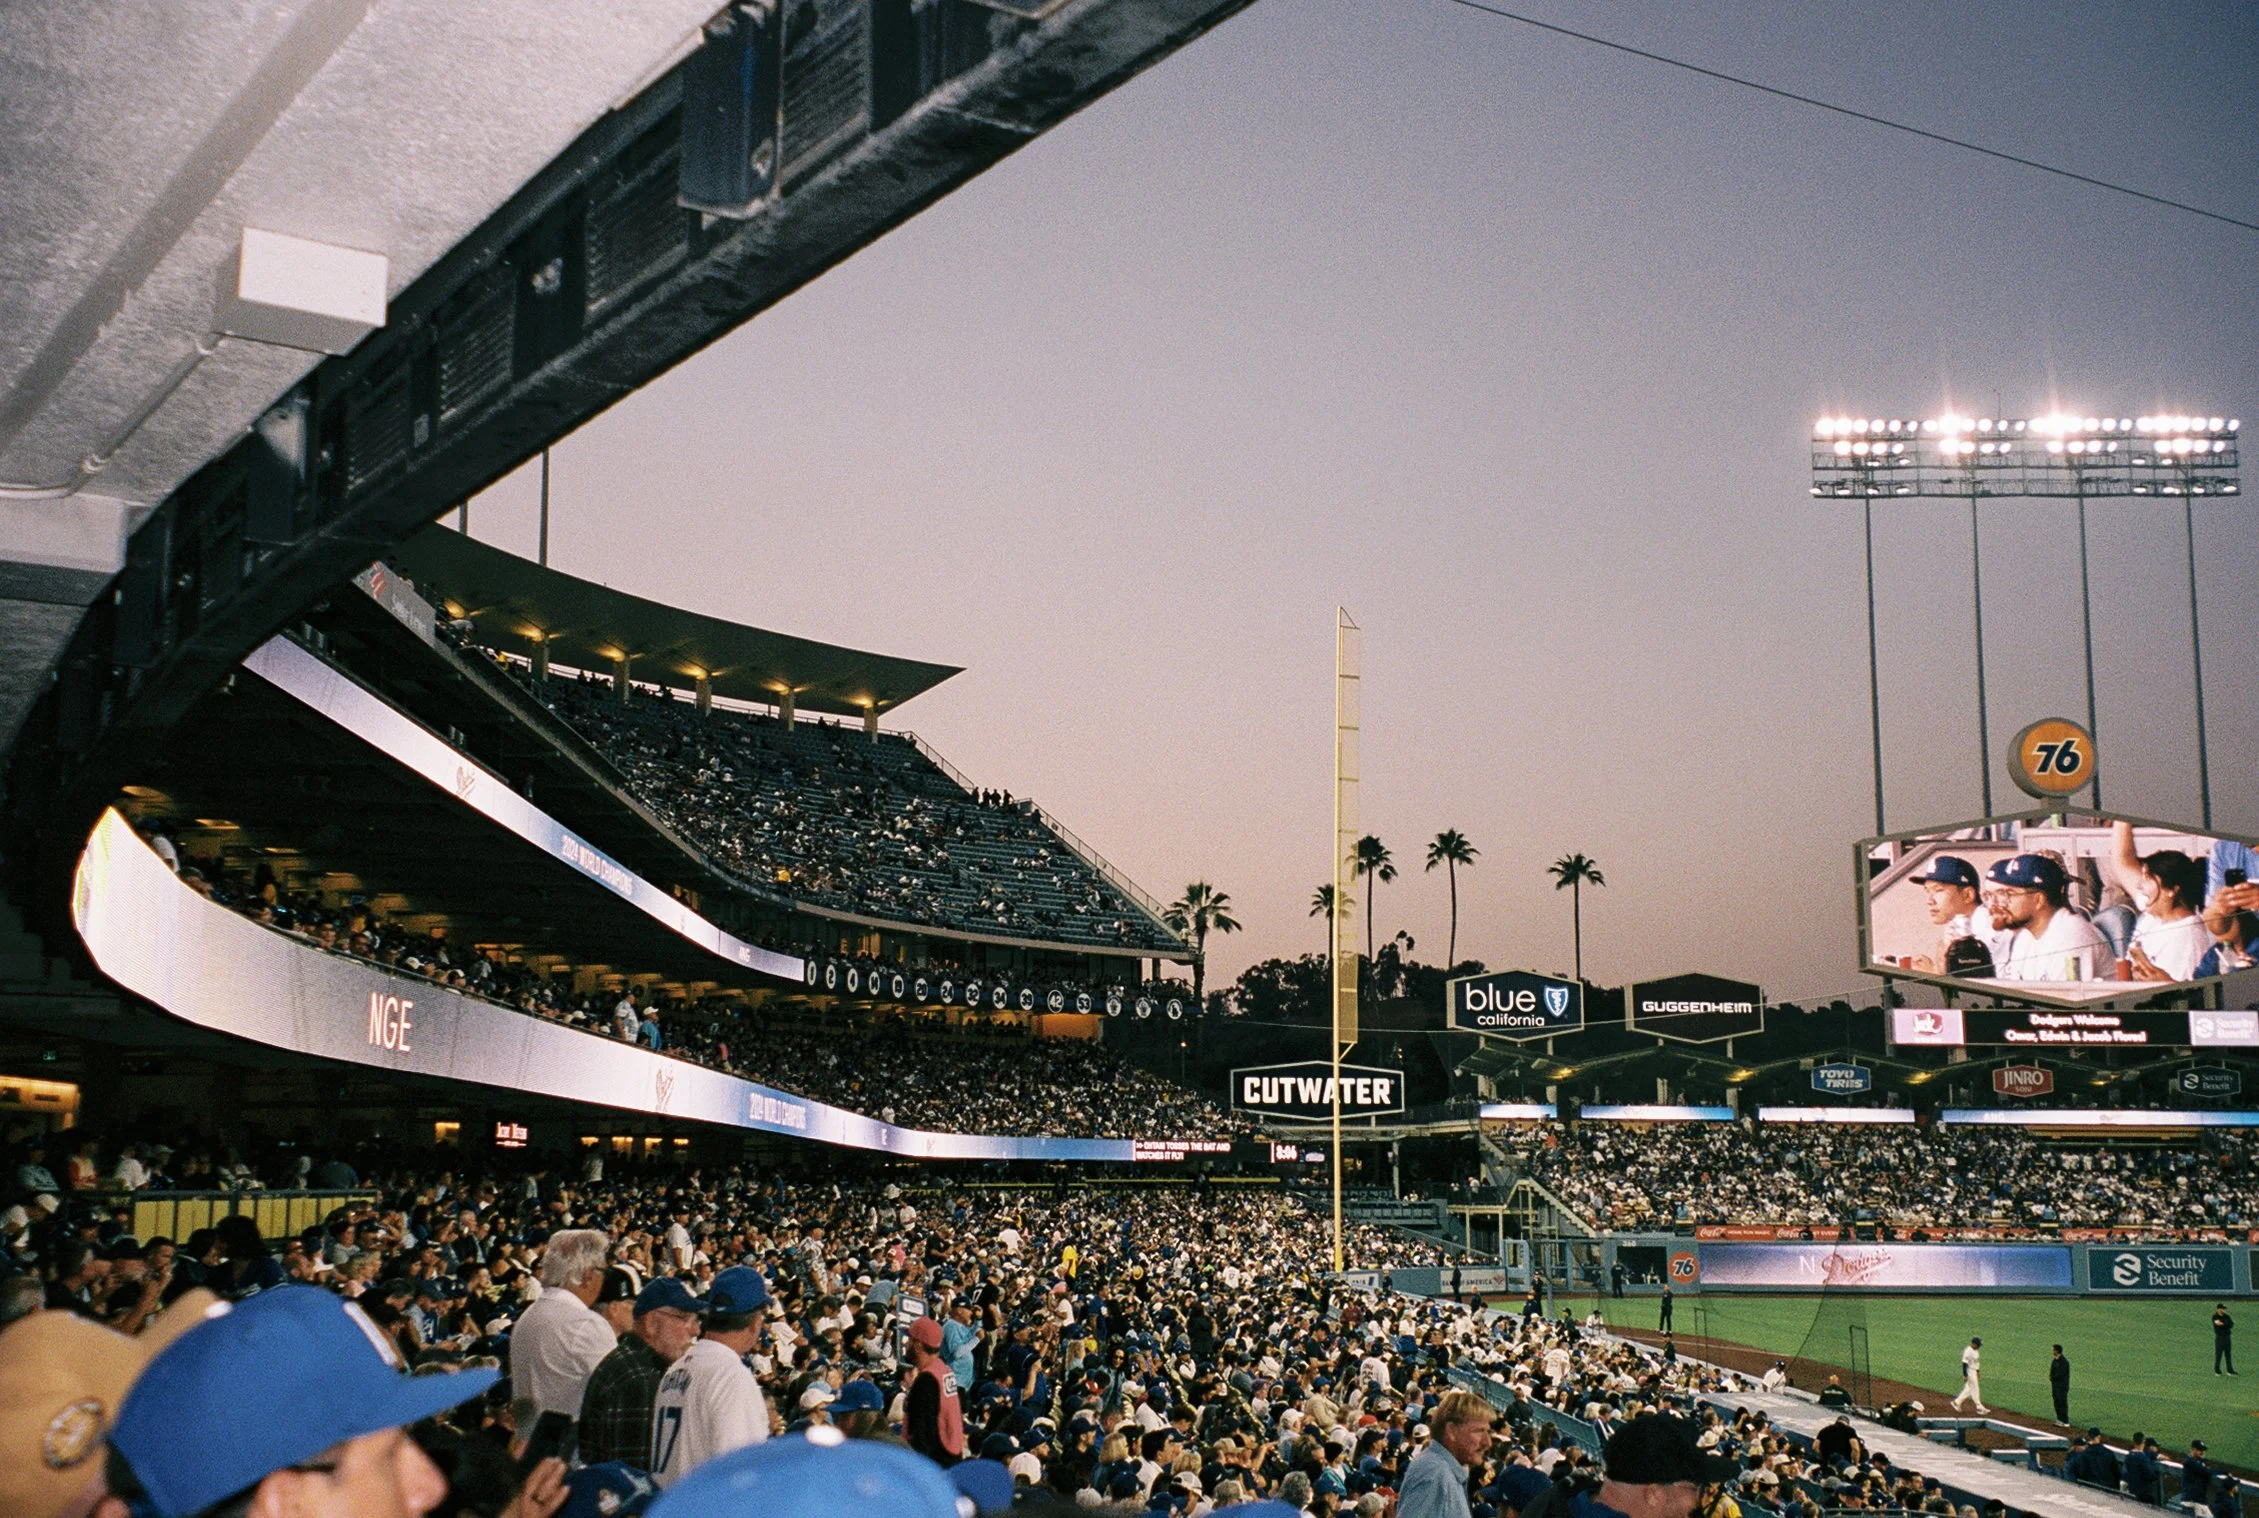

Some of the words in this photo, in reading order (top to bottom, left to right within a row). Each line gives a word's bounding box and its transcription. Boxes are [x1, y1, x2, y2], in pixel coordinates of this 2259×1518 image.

[2032, 738, 2083, 776] 76
[917, 982, 927, 996] 20
[942, 985, 953, 999] 24
[968, 987, 980, 1002] 32
[993, 990, 1006, 1006] 34
[1020, 992, 1033, 1006] 39
[1049, 994, 1063, 1010] 42
[1077, 996, 1090, 1010] 53
[1465, 982, 1537, 1012] blue
[1642, 1000, 1753, 1014] GUGGENHEIM
[369, 991, 414, 1052] NGE
[1477, 1013, 1545, 1027] california
[2028, 1013, 2073, 1028] Dodgers
[2073, 1013, 2121, 1026] Welcome
[2071, 1029, 2081, 1041] &
[2082, 1029, 2112, 1041] Jacob
[1820, 1069, 1855, 1079] TOYO
[2003, 1070, 2044, 1089] JINRO
[2202, 1071, 2234, 1083] Security
[1243, 1077, 1392, 1105] CUTWATER
[1825, 1079, 1864, 1089] TIRES
[2203, 1082, 2230, 1091] Benefit
[1190, 1142, 1203, 1151] THE
[1203, 1142, 1216, 1151] BAT
[1216, 1142, 1231, 1152] AND
[1672, 1258, 1696, 1277] 76
[1800, 1255, 1815, 1273] N
[2146, 1254, 2207, 1272] Security
[2149, 1271, 2200, 1286] Benefit
[653, 1406, 683, 1475] 17
